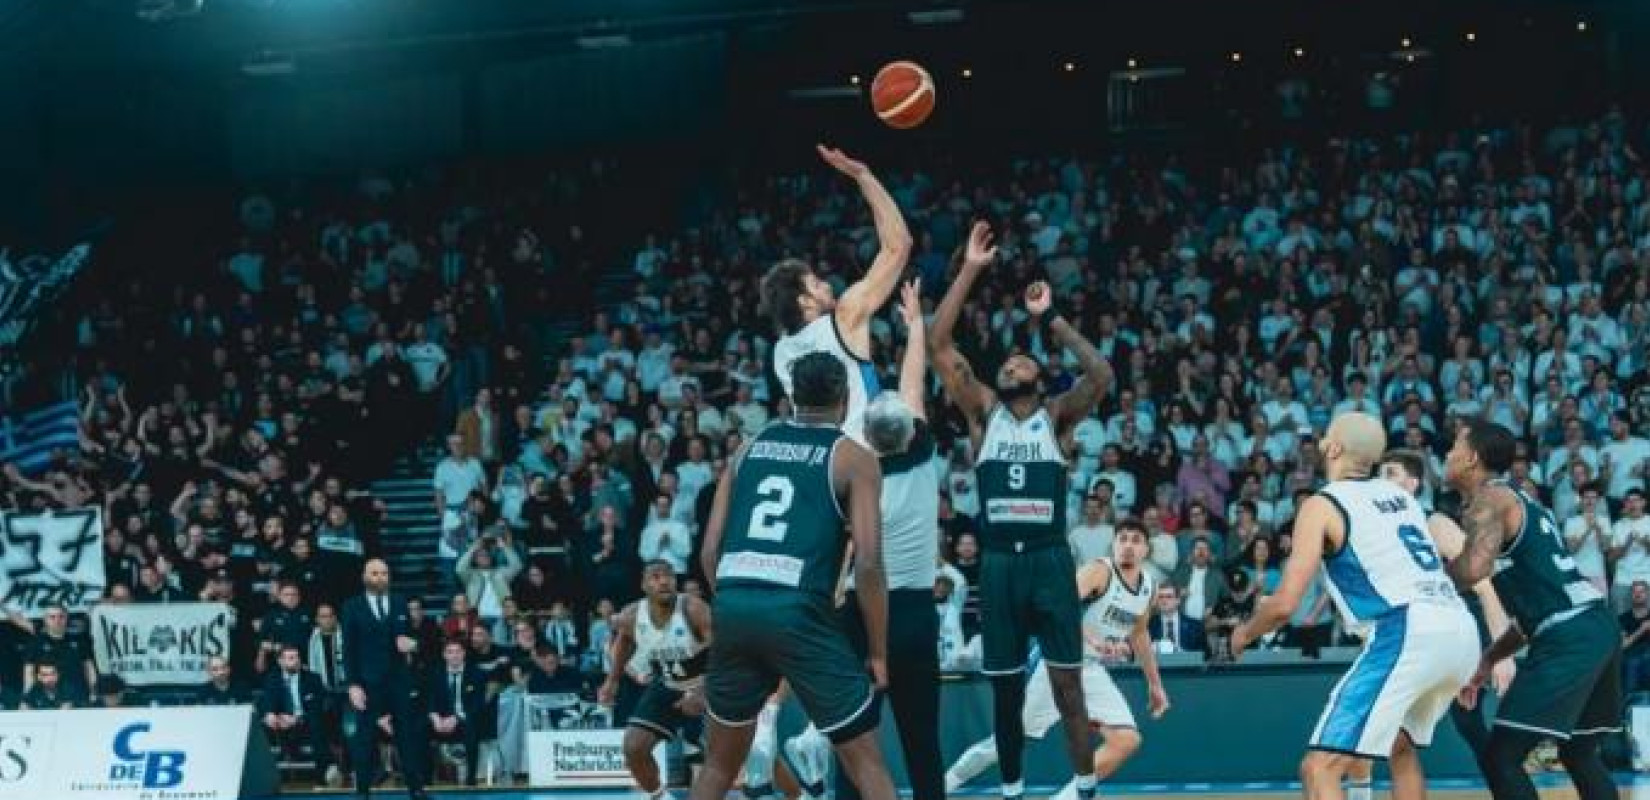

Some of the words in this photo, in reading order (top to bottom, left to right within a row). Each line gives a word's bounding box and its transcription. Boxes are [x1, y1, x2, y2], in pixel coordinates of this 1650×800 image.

[1008, 463, 1026, 491] 9
[747, 475, 795, 542] 2
[0, 511, 99, 578] 57
[1397, 524, 1440, 571] 6
[554, 742, 622, 760] Freiburge
